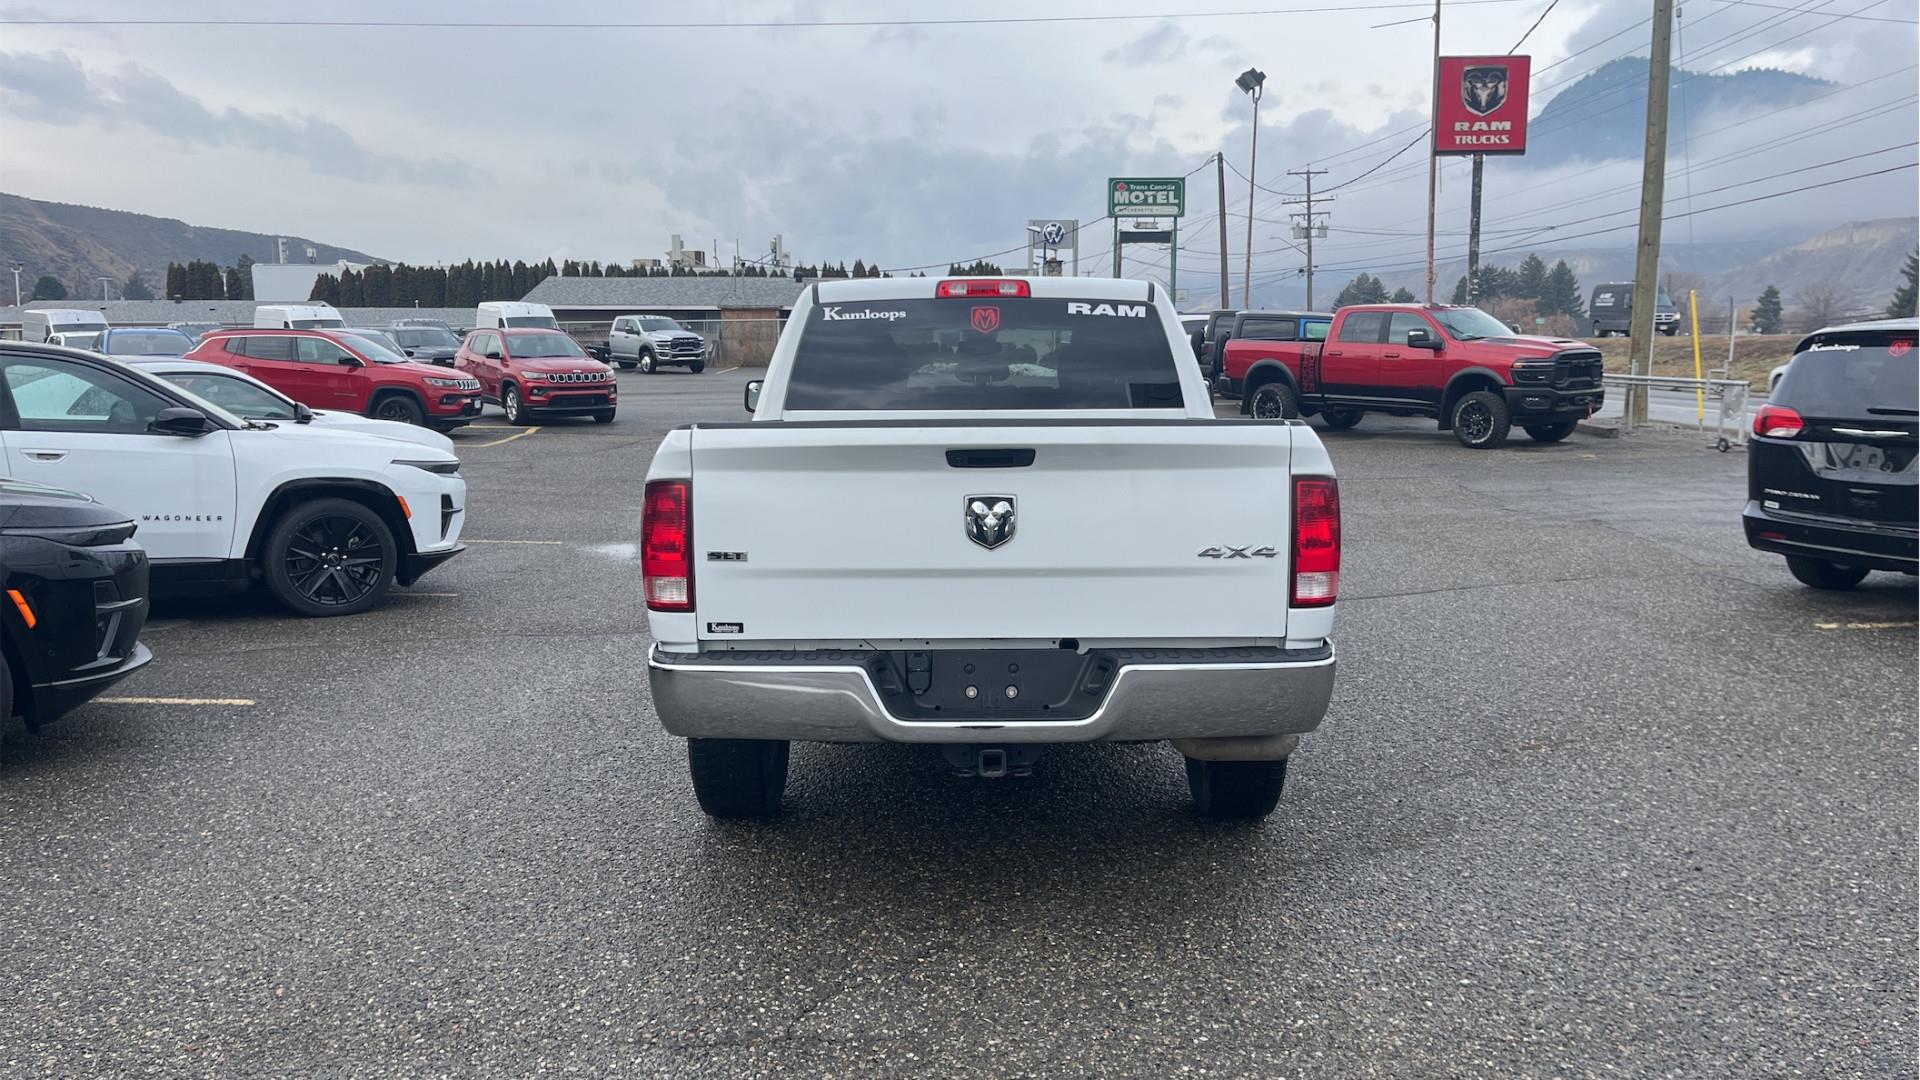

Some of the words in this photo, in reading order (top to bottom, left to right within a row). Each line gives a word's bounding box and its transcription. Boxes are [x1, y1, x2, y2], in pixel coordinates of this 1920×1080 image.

[1454, 121, 1511, 131] RAM
[1454, 135, 1510, 145] TRUCKS
[1114, 191, 1179, 204] MOTEL
[823, 306, 907, 321] Kamloops
[1067, 302, 1146, 318] RAM
